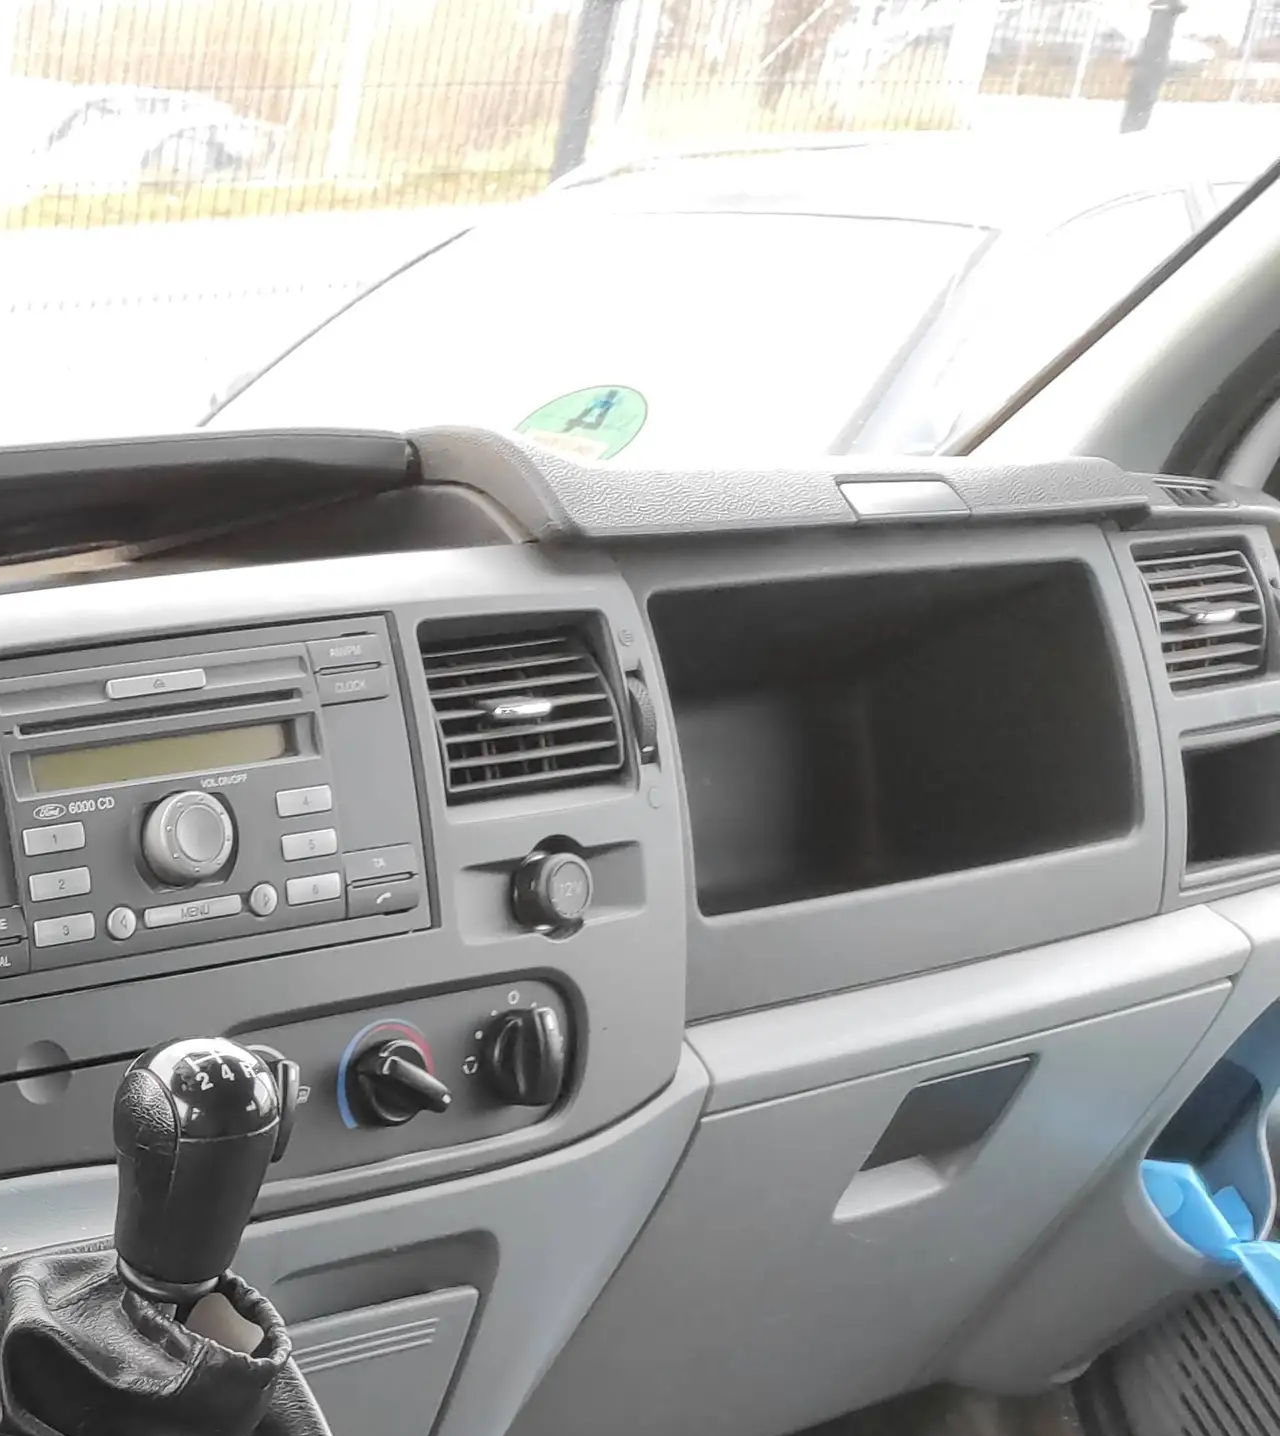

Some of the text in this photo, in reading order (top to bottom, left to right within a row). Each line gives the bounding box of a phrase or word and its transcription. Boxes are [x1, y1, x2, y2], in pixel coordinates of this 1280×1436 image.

[68, 800, 96, 814] 6000
[97, 796, 115, 810] CD
[372, 857, 386, 868] TA
[58, 878, 65, 890] 2
[181, 903, 210, 920] MENU
[221, 1063, 235, 1081] 4
[195, 1071, 215, 1091] 2
